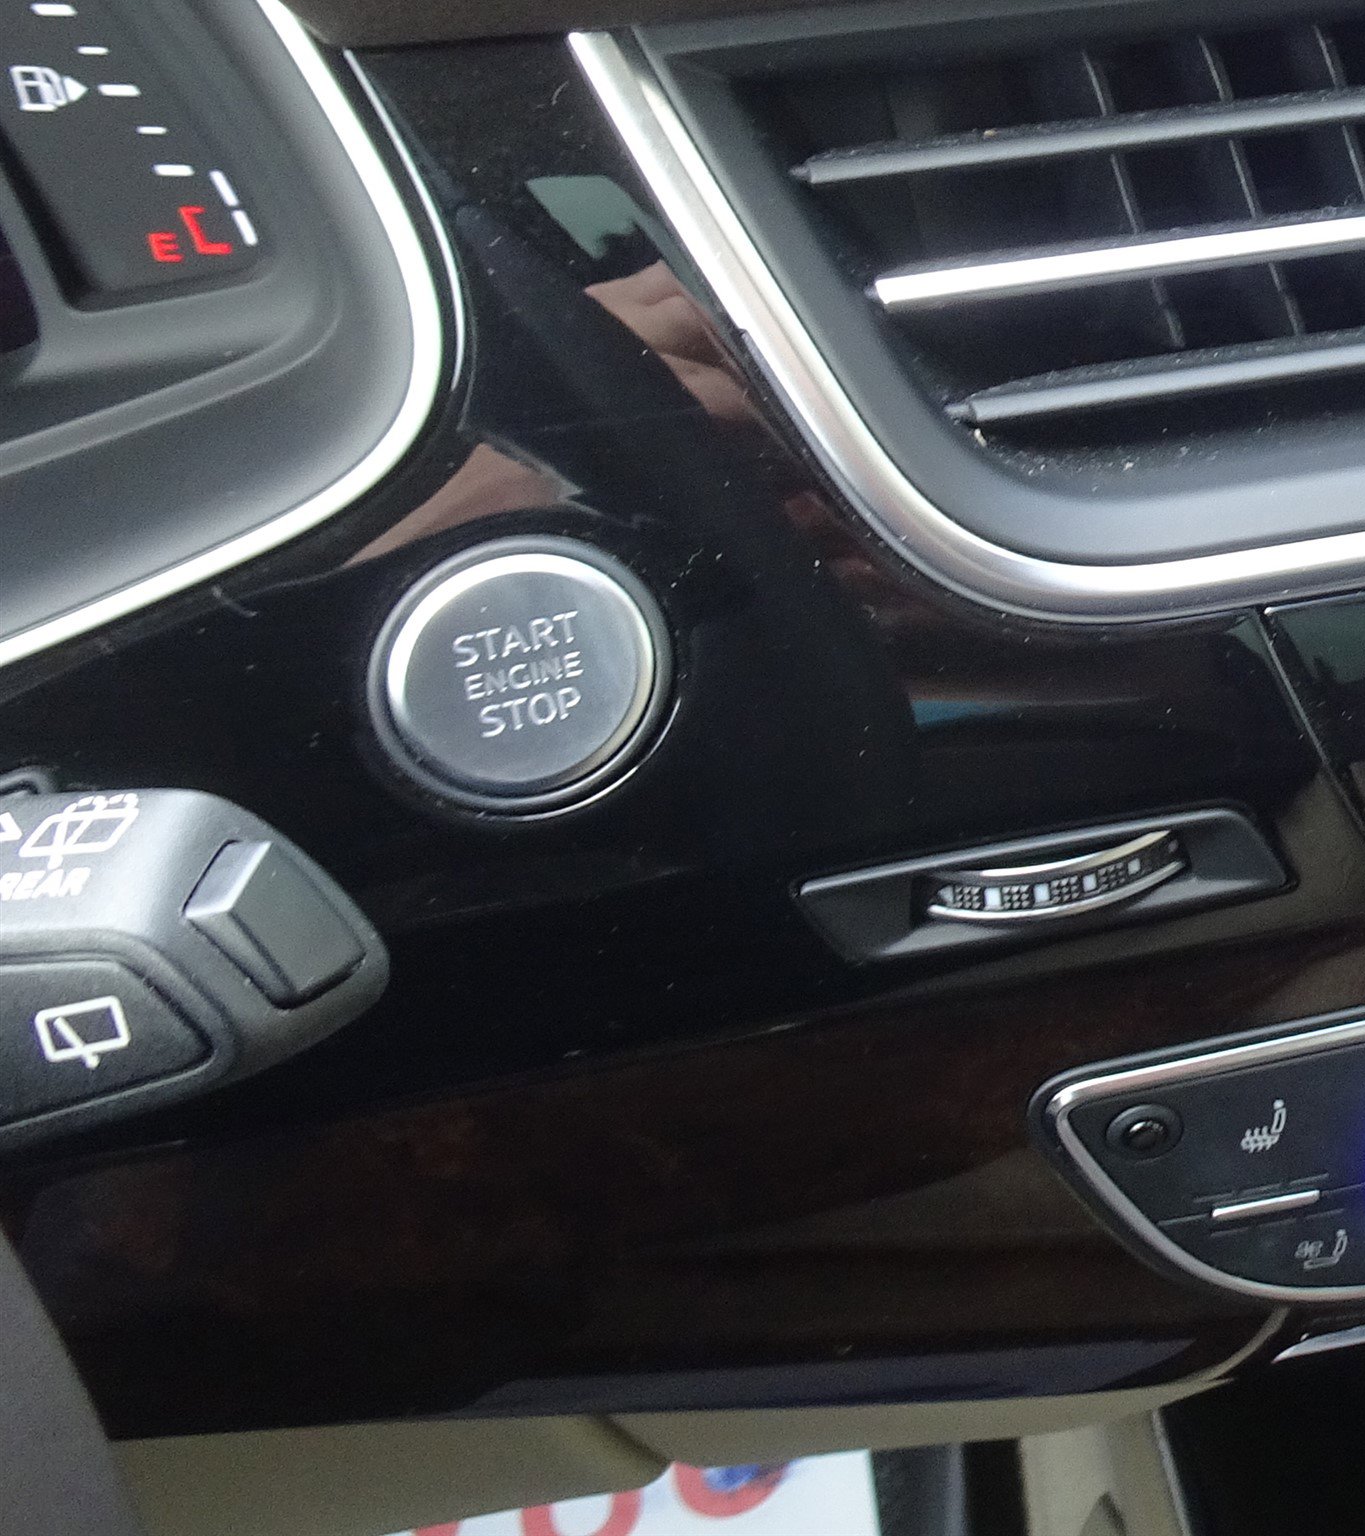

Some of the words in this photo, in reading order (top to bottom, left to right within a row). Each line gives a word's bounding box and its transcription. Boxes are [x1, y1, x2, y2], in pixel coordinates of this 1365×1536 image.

[452, 608, 579, 670] START
[463, 650, 585, 701] ENGINE
[477, 688, 583, 740] STOP
[0, 866, 92, 902] REAR
